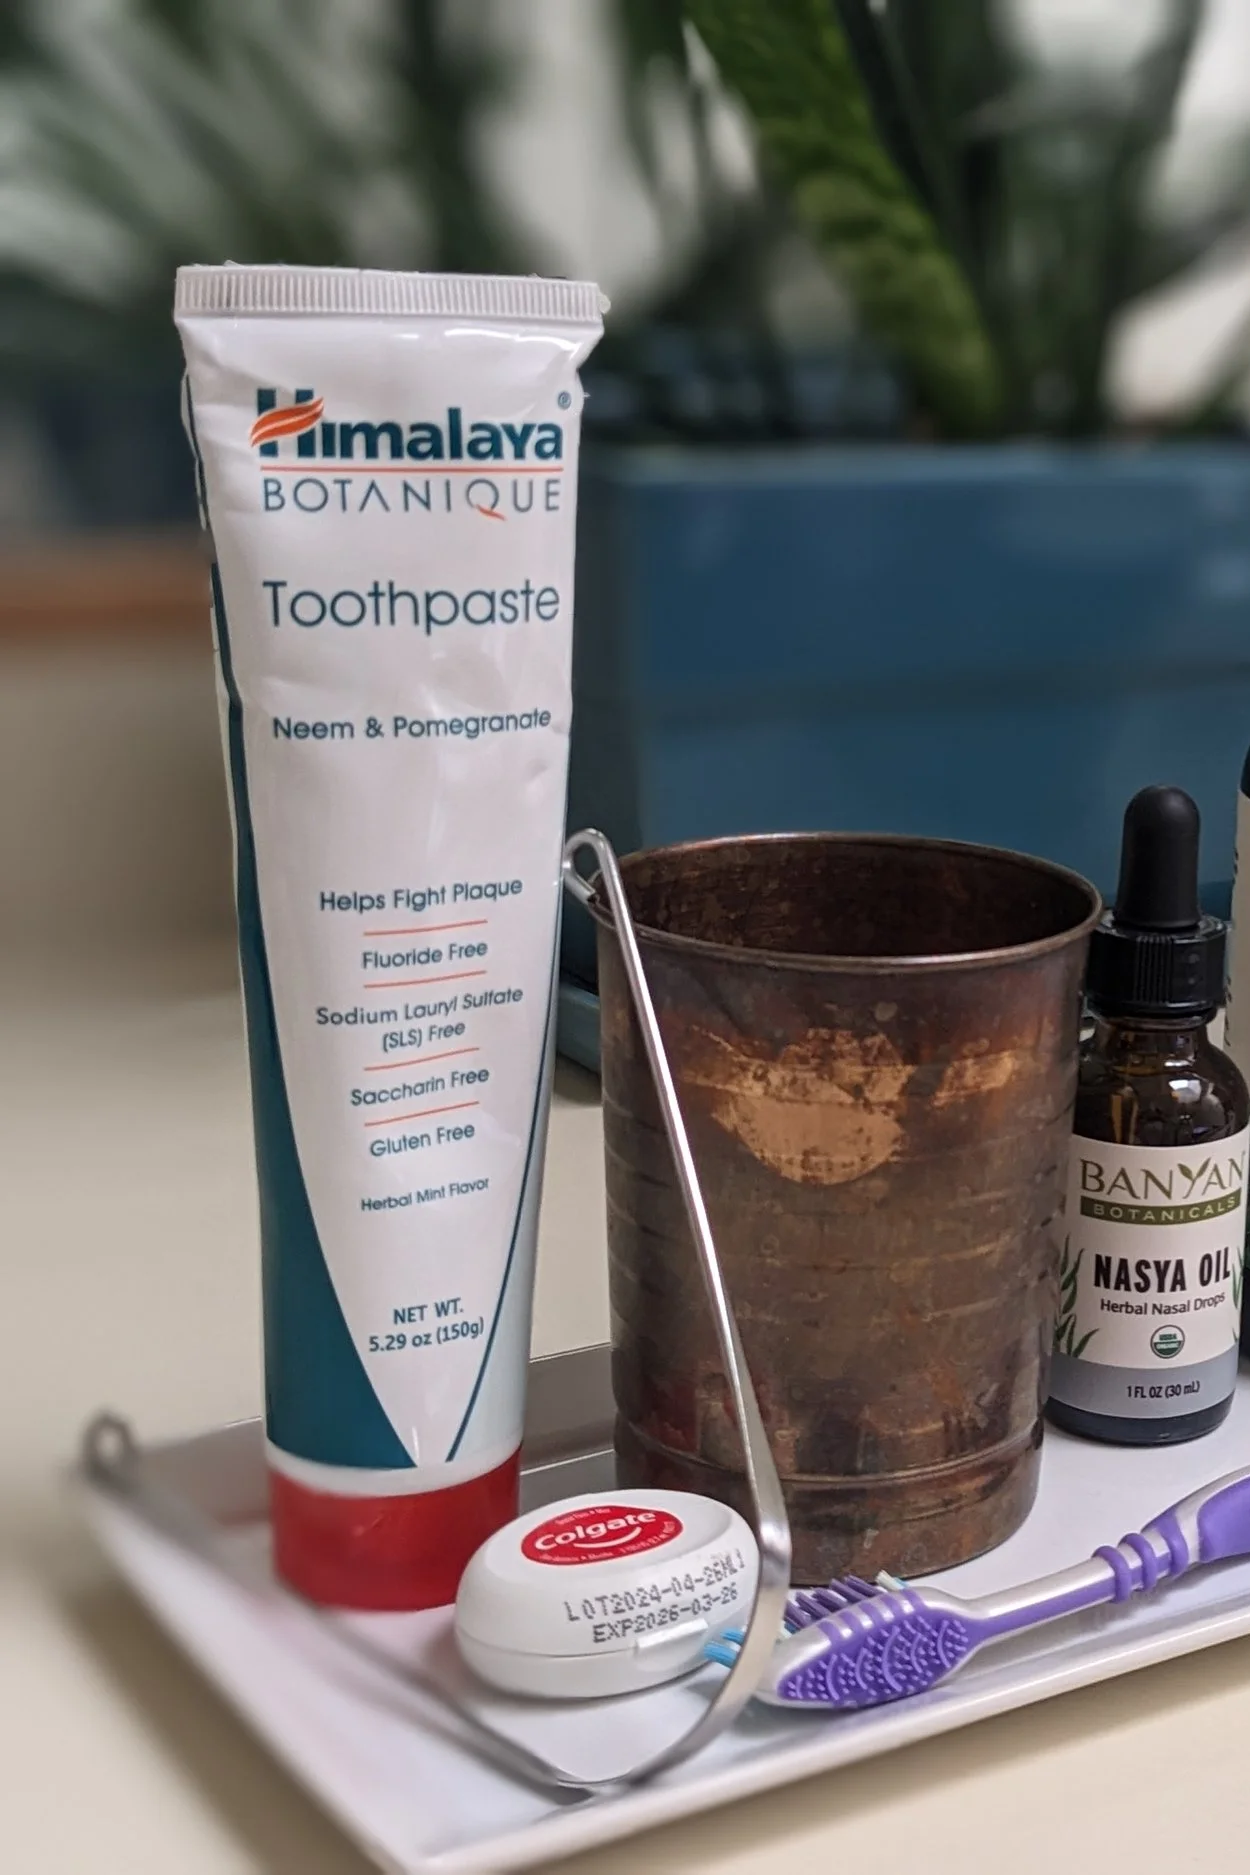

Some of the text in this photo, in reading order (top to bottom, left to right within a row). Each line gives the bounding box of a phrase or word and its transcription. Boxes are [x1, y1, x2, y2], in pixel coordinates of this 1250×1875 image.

[252, 388, 564, 460] Himalaya
[263, 478, 561, 520] BOTANIQUE
[262, 579, 560, 635] Toothpaste
[273, 708, 552, 741] Neem & Pomegranate
[320, 877, 523, 914] Helps Fight Plaque
[362, 940, 488, 970] Fluoride Free
[316, 988, 524, 1025] Sodium Lauryl Sulfate
[382, 1022, 465, 1053] (SLS) Free
[351, 1069, 490, 1106] Saccharin Free
[370, 1124, 475, 1157] Gluten Free
[1080, 1151, 1246, 1200] BANYAN
[361, 1178, 489, 1211] Herbal Mint Flavor
[1093, 1196, 1236, 1221] BOTANICALS
[1094, 1247, 1231, 1294] NASYA OIL
[393, 1297, 464, 1325] NET WT.
[1100, 1291, 1225, 1316] Herbal Nasal Drops
[369, 1316, 484, 1352] 5.29 oz (150g)
[1127, 1380, 1200, 1398] 1 FL OZ (30 mL)
[534, 1512, 656, 1550] Colgate
[592, 1582, 738, 1643] EXP2026-03-26
